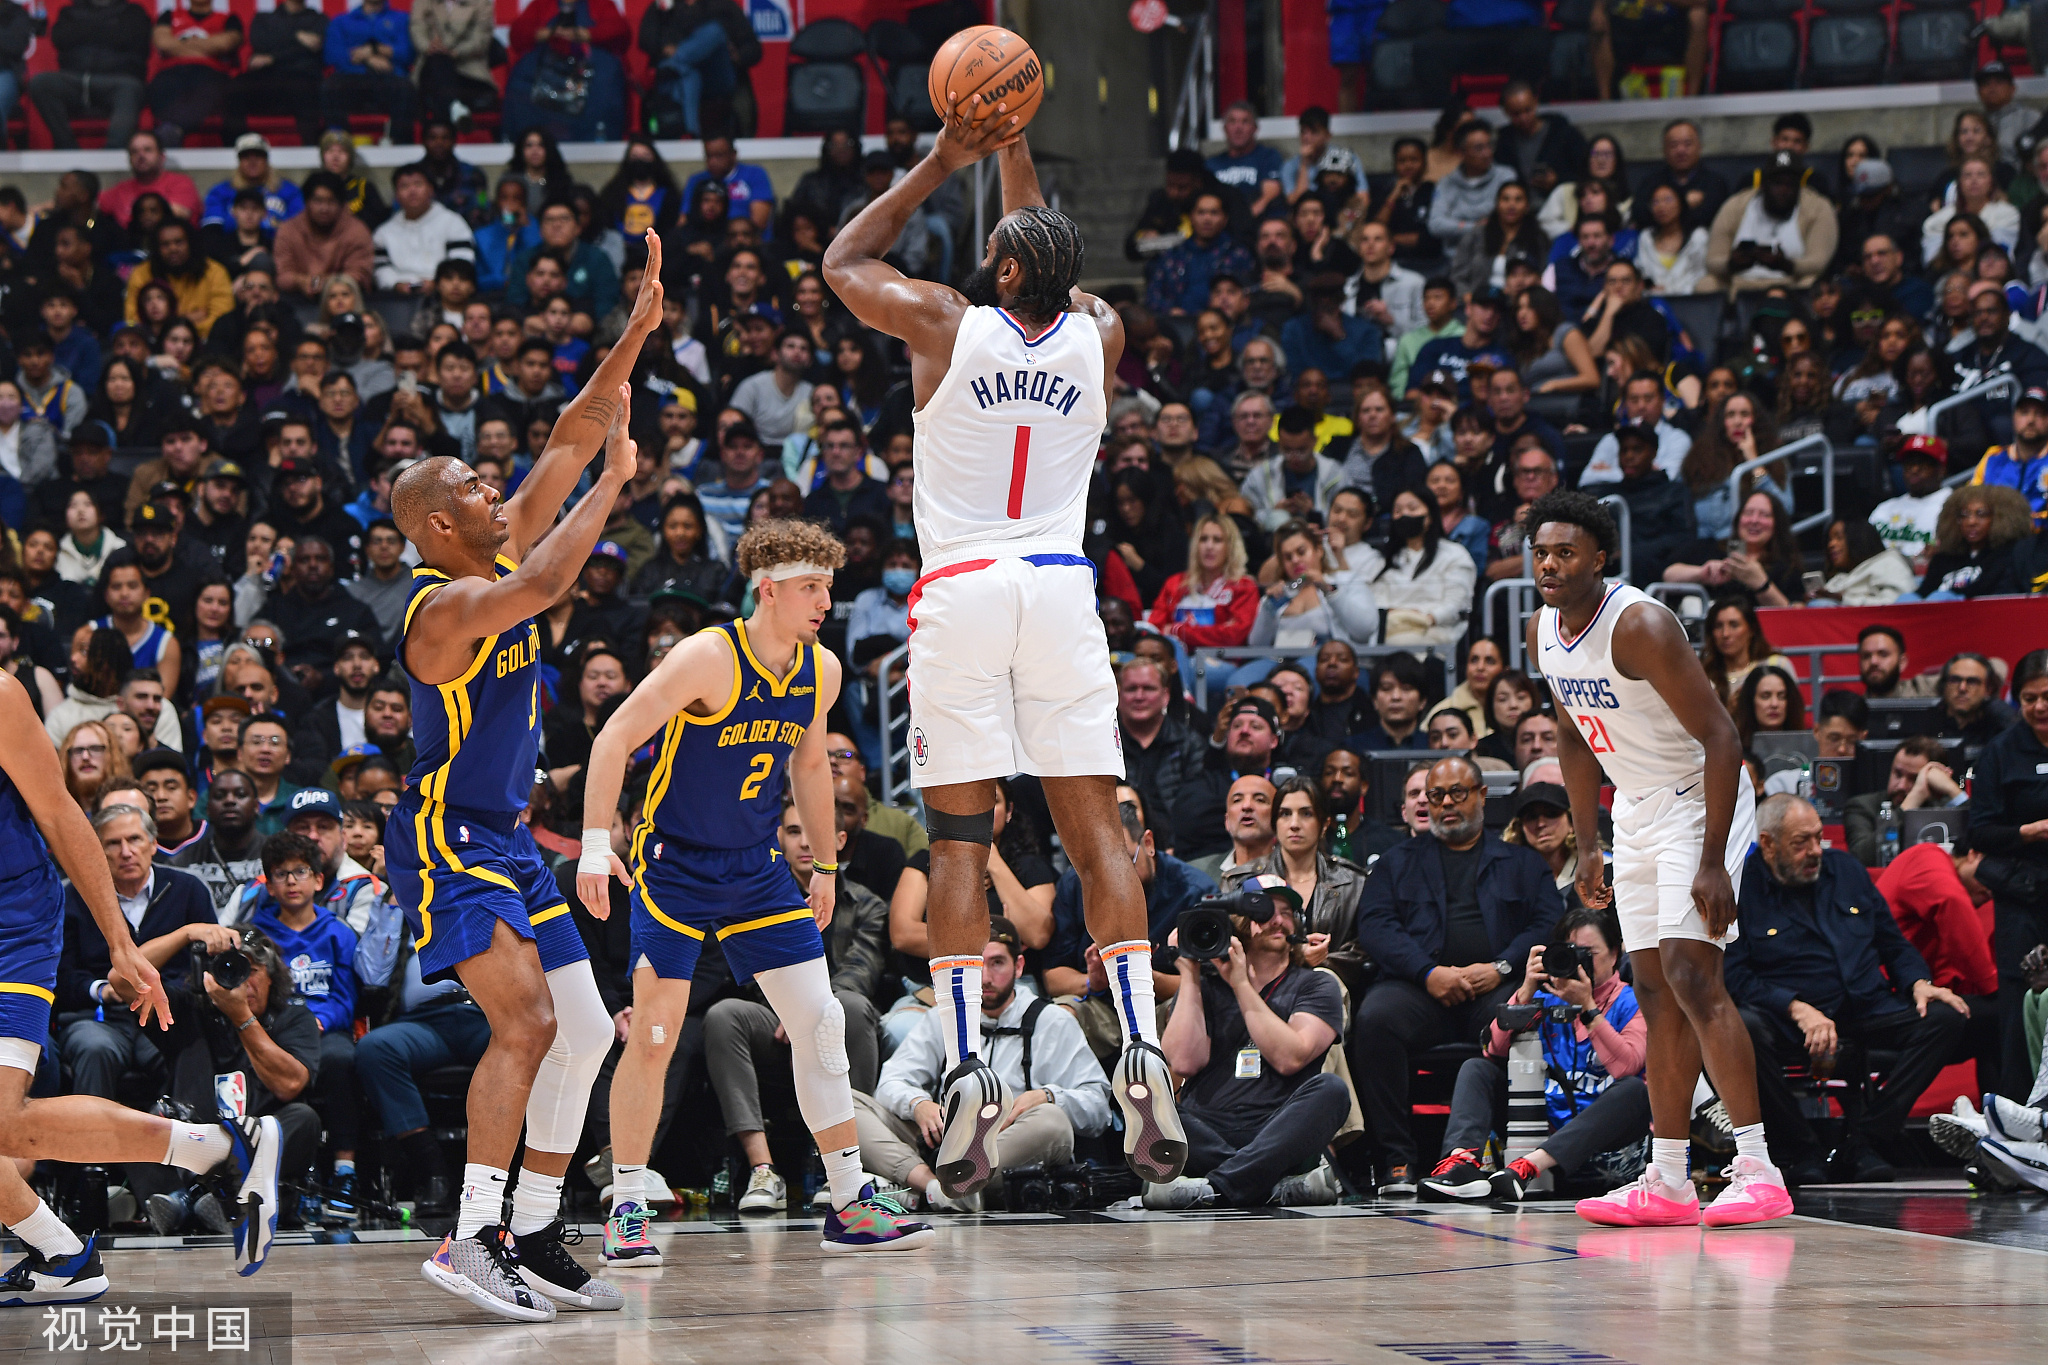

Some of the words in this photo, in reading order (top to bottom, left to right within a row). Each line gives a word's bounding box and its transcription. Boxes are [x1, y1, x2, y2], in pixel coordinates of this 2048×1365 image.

[982, 57, 1040, 106] Wilson
[970, 370, 1082, 417] HARDEN
[1007, 425, 1031, 519] 1
[717, 719, 780, 748] GOLDEN
[777, 721, 806, 749] STAT
[1577, 715, 1616, 754] 21
[291, 789, 330, 810] Clips
[739, 752, 774, 801] 2
